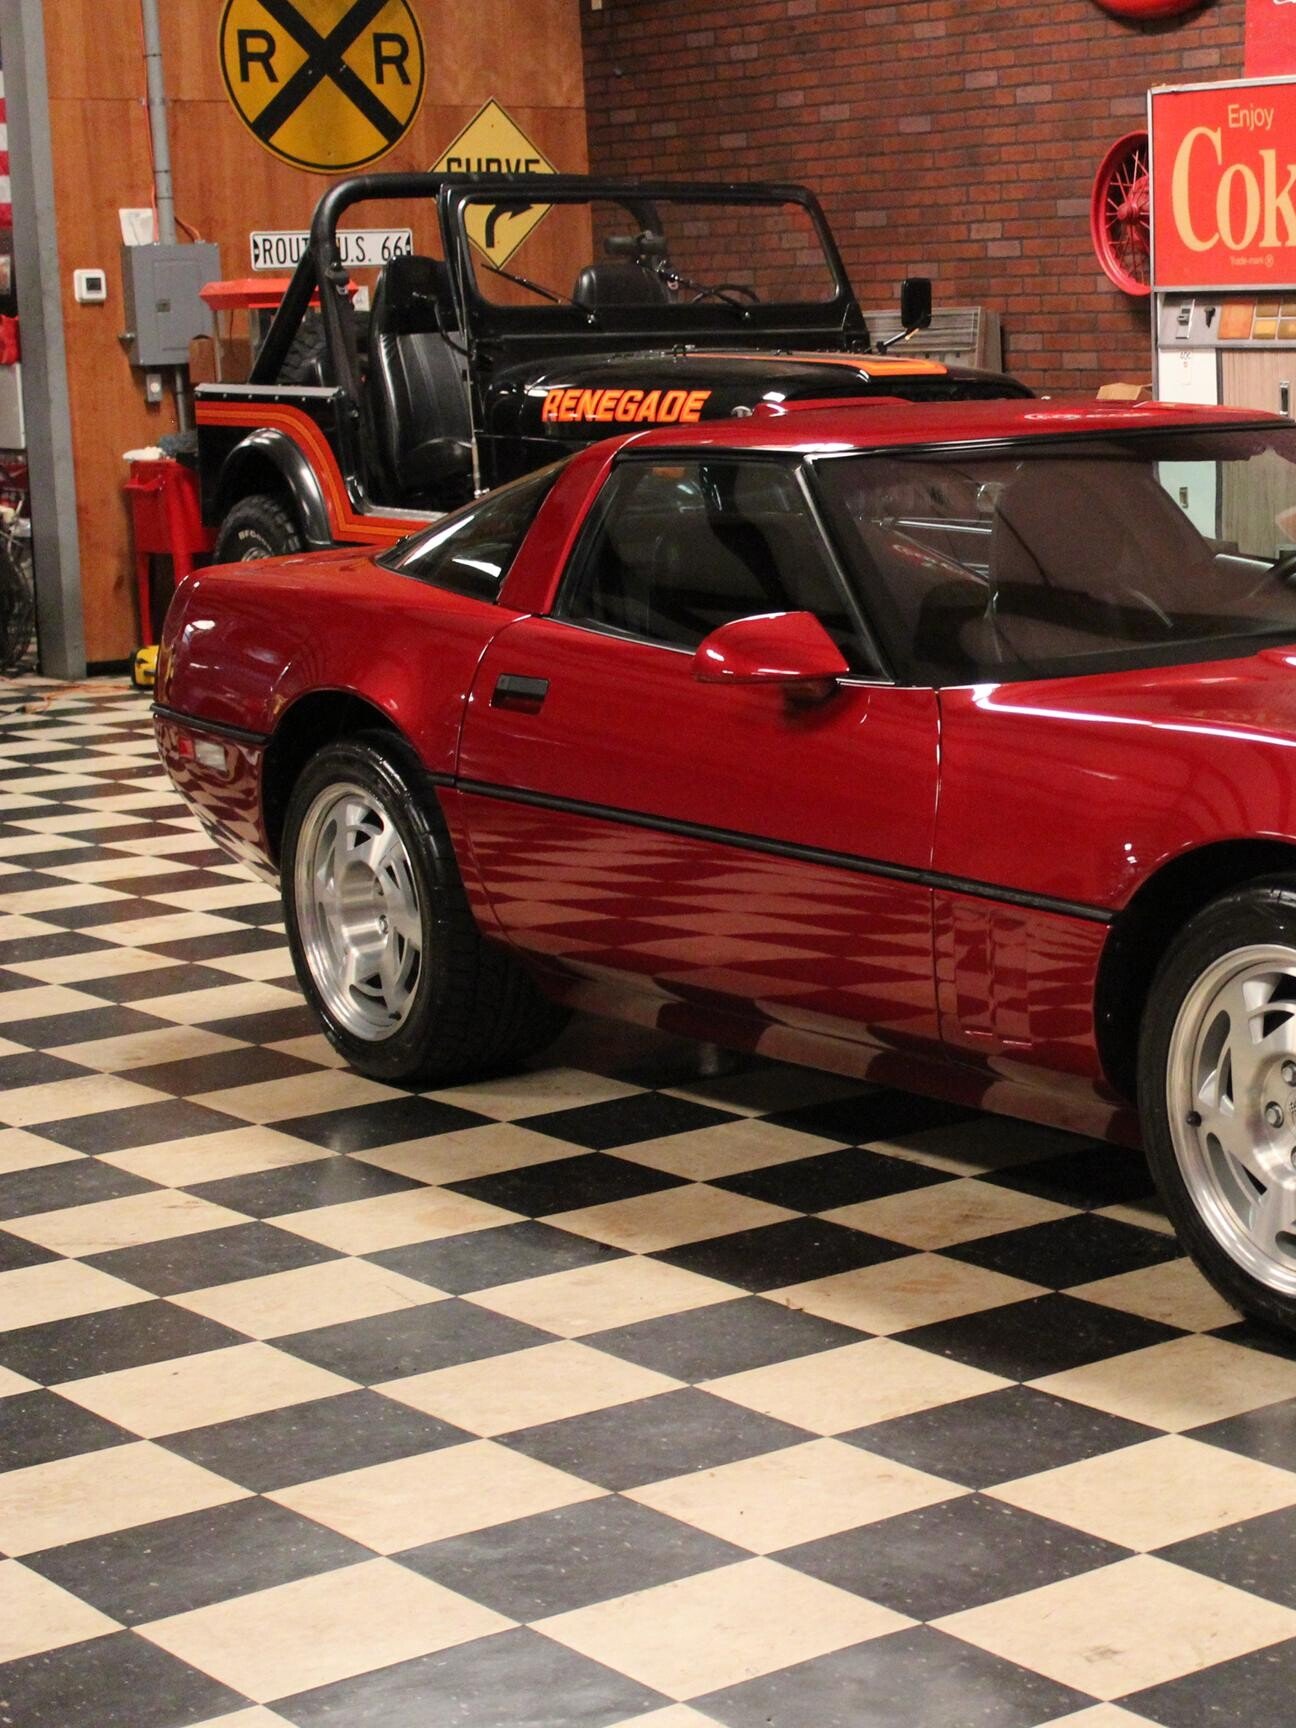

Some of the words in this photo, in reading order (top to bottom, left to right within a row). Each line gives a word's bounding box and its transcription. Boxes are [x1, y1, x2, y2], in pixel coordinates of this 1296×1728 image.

[237, 28, 279, 83] R
[372, 32, 411, 85] R
[1227, 103, 1274, 131] Enjoy
[262, 237, 310, 264] ROUT
[381, 236, 403, 262] 66
[541, 388, 712, 423] RENEGADE
